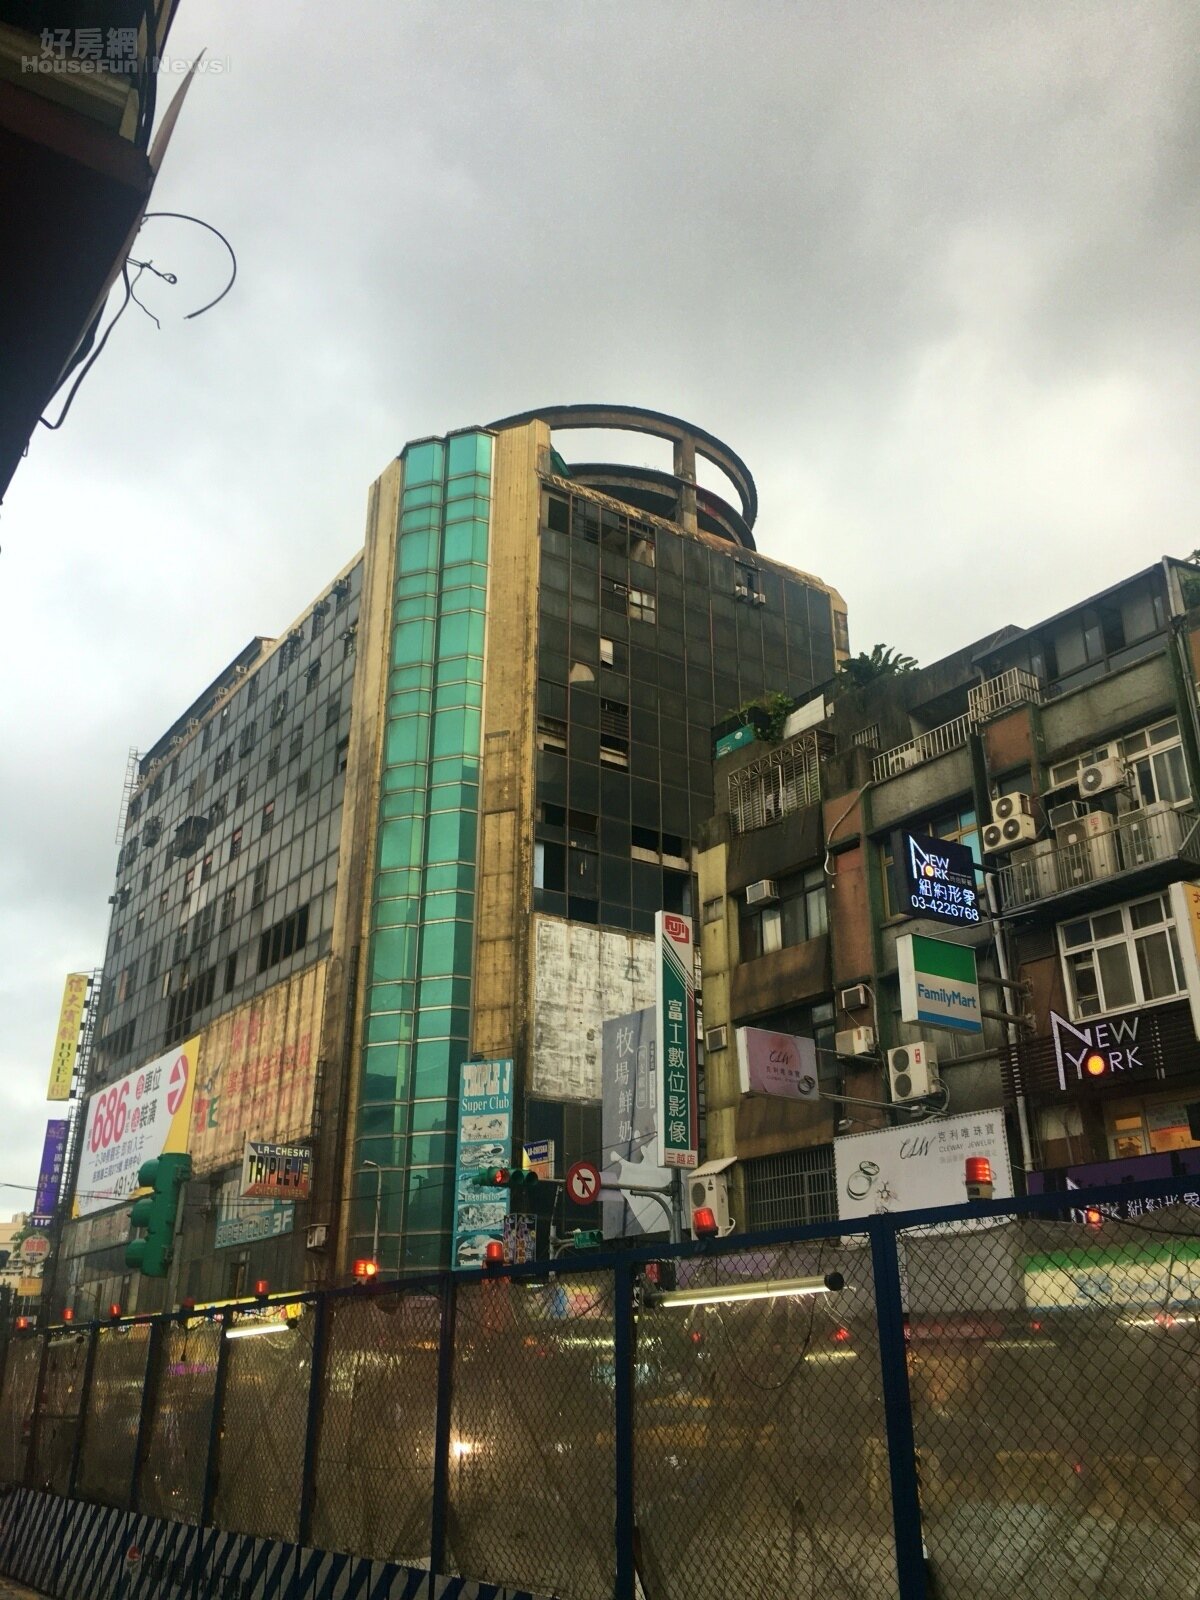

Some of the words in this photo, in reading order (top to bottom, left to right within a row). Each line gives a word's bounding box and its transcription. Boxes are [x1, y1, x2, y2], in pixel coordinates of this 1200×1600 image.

[908, 834, 949, 879] NEW
[916, 858, 949, 881] YORK
[918, 878, 975, 906] 紐約形象
[911, 894, 979, 921] 03-4226768
[917, 983, 977, 1008] FamilyMart
[56, 1042, 71, 1083] HOTEL
[1050, 1010, 1139, 1090] NEW
[1064, 1046, 1143, 1080] YORK
[615, 1026, 634, 1142] 牧場鮮奶
[667, 999, 687, 1144] 富士數位影像
[91, 1080, 130, 1153] 686
[461, 1097, 487, 1113] Super
[489, 1095, 510, 1110] Club
[257, 1145, 310, 1158] LA-CHESKA
[666, 1151, 696, 1166] 三越店
[248, 1155, 292, 1186] TRIPLE
[272, 1209, 293, 1234] 3F
